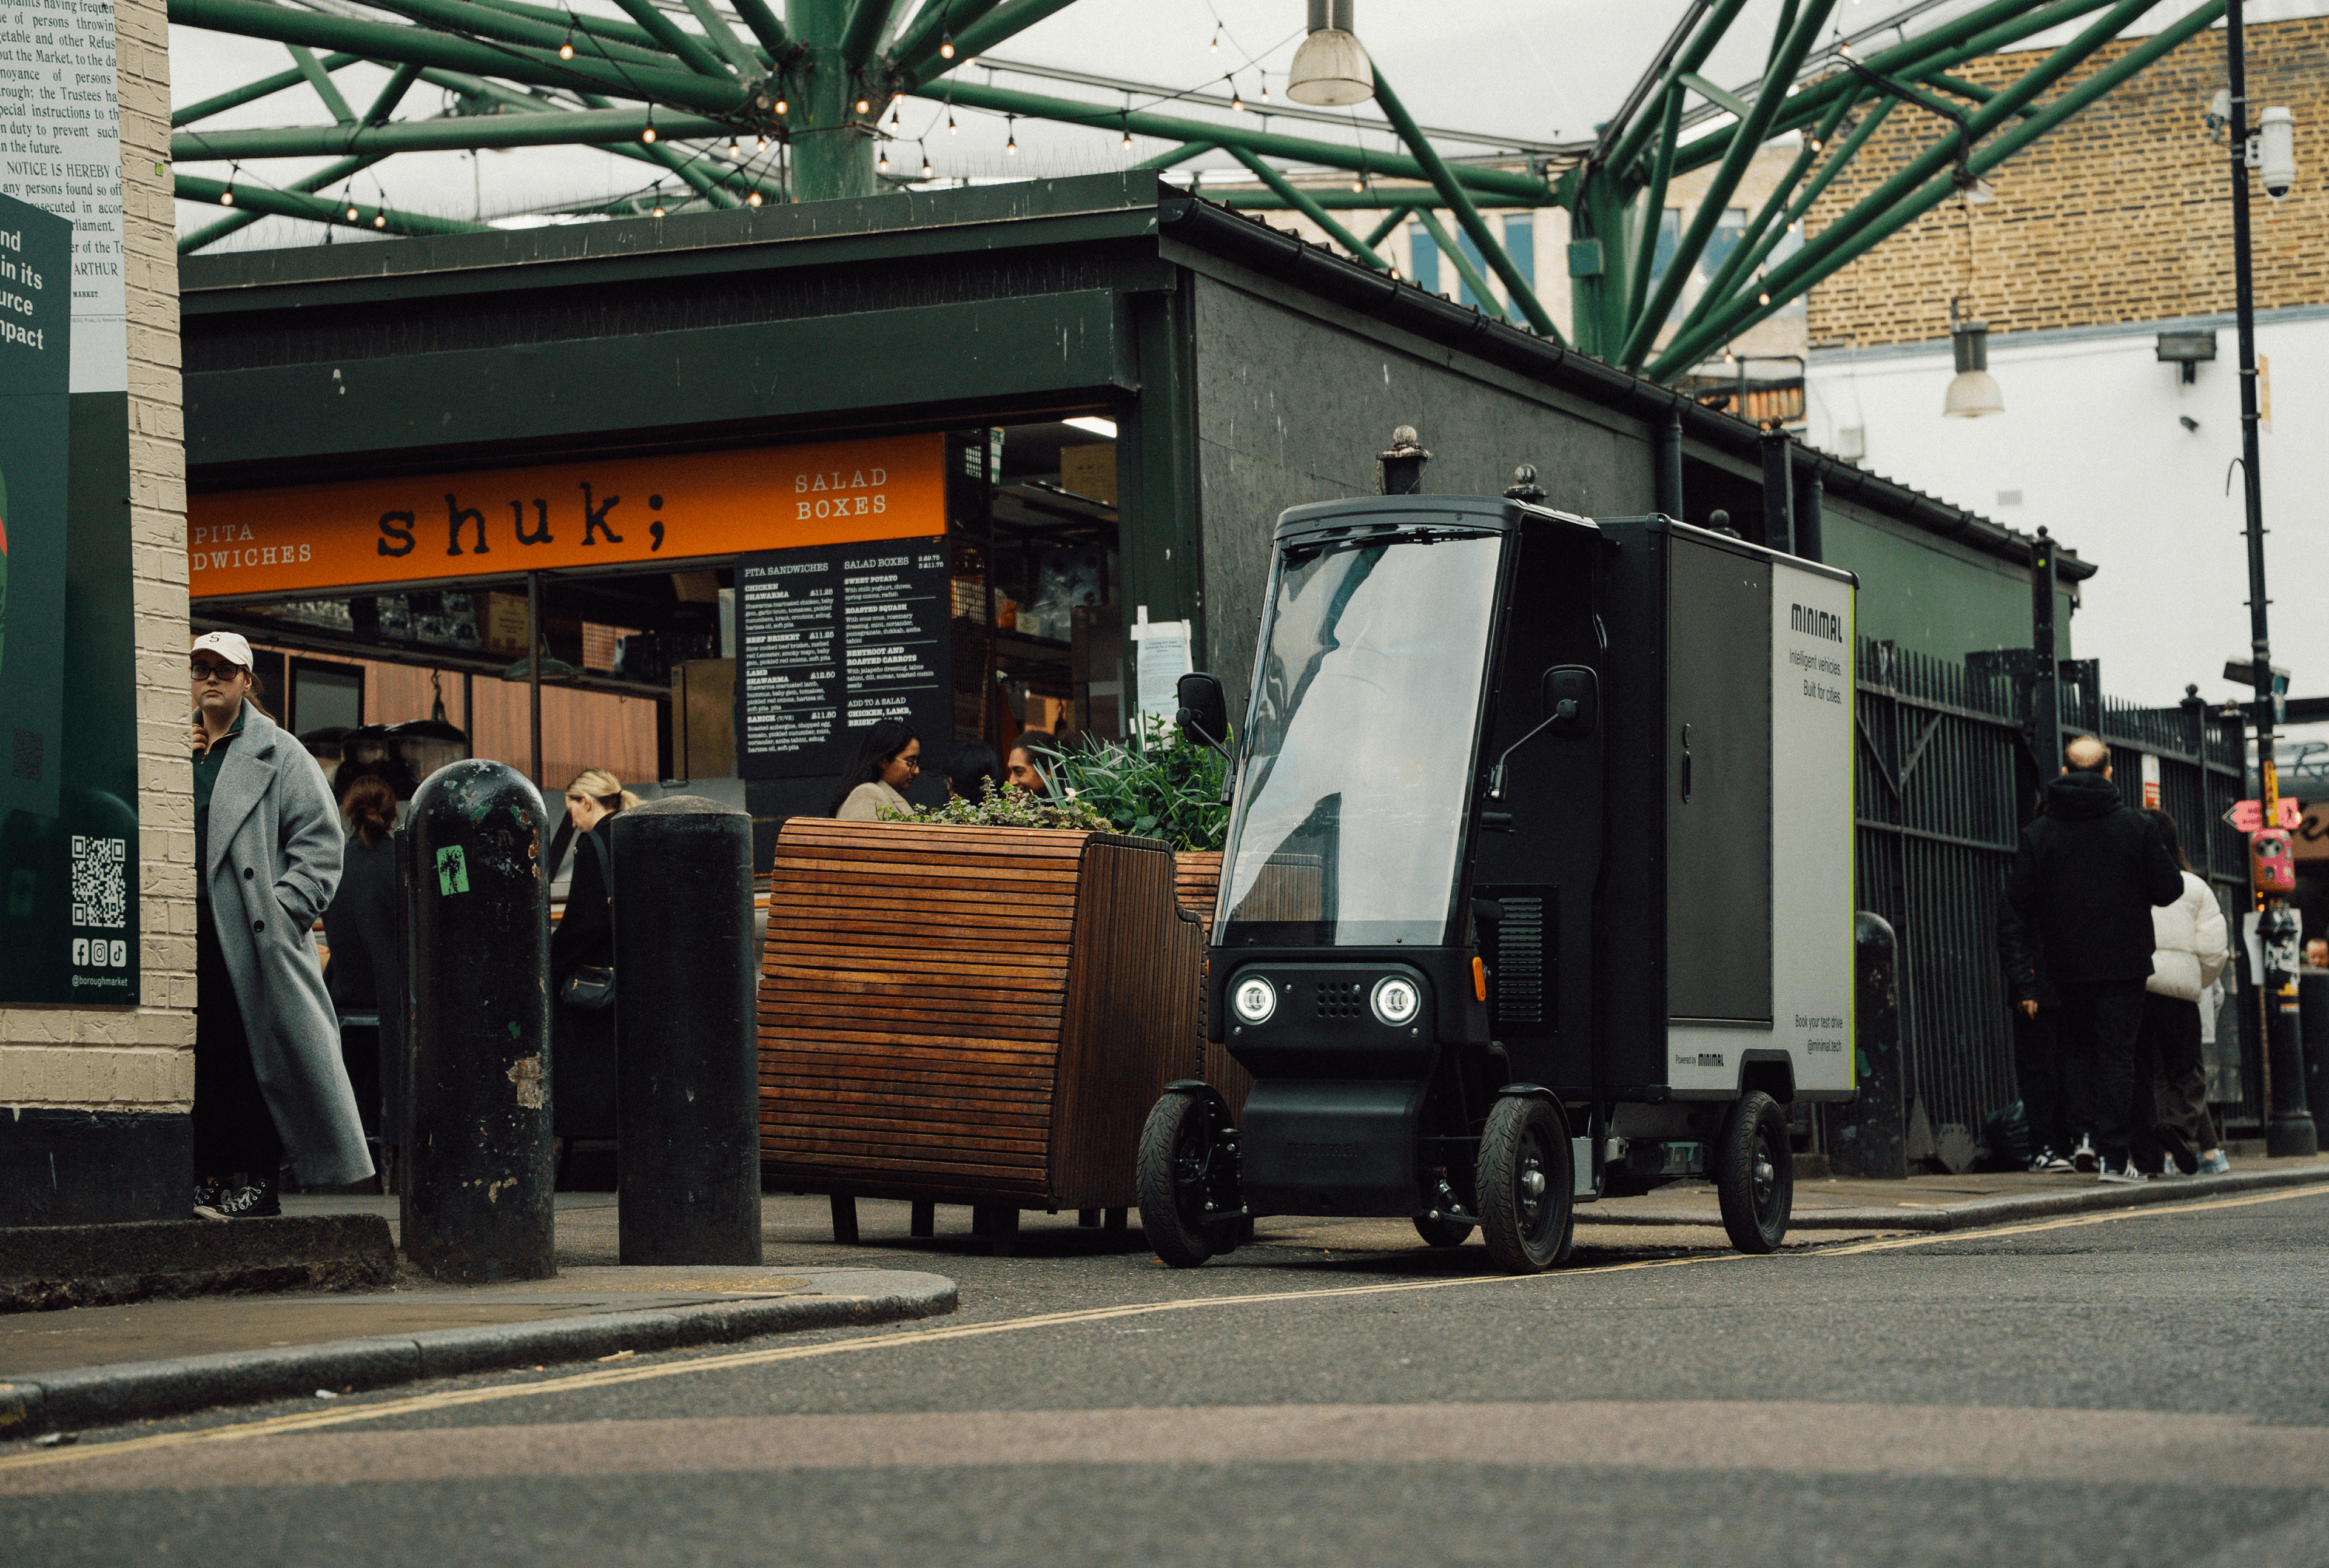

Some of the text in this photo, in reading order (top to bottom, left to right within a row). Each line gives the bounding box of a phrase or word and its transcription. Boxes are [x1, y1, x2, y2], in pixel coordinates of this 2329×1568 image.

[44, 0, 76, 14] having
[15, 12, 23, 24] of
[33, 16, 69, 29] persons
[0, 30, 30, 44] etable
[36, 33, 53, 45] and
[59, 34, 84, 47] other
[16, 49, 32, 61] the
[36, 50, 73, 66] Market,
[76, 54, 86, 65] to
[87, 54, 103, 66] the
[53, 69, 61, 82] of
[75, 73, 112, 86] persons
[39, 86, 55, 99] the
[60, 87, 101, 101] Trustees
[32, 104, 90, 119] instructions
[95, 108, 104, 119] to
[10, 122, 32, 137] duty
[37, 124, 46, 135] to
[53, 126, 89, 138] prevent
[97, 126, 118, 138] such
[10, 140, 26, 152] the
[30, 141, 62, 154] future.
[7, 161, 47, 176] NOTICE
[52, 164, 62, 176] IS
[67, 164, 110, 178] HEREBY
[3, 183, 20, 196] any
[25, 184, 62, 197] persons
[66, 183, 92, 195] found
[97, 186, 106, 196] so
[82, 201, 92, 213] in
[82, 240, 91, 254] of
[95, 241, 110, 253] the
[21, 262, 42, 290] its
[74, 262, 119, 277] ARTHUR
[795, 468, 887, 493] SALAD
[796, 494, 887, 520] BOXES
[377, 482, 665, 557] shuk;
[194, 523, 255, 545] PITA
[192, 543, 311, 571] DWICHES
[844, 557, 909, 570] SALAD BOXES
[745, 563, 828, 577] PITA SANDWICHES
[870, 574, 898, 583] POTATO
[745, 583, 779, 592] CHICKEN
[745, 591, 789, 601] SHAWARMA
[845, 604, 907, 614] ROASTED SQUASH
[210, 634, 220, 642] S
[767, 633, 800, 642] BRISKET
[847, 648, 886, 657] BEETROOT
[847, 654, 917, 666] ROASTED CARROTS
[1789, 647, 1842, 676] Intelligent vehicles.
[747, 676, 789, 685] SHAWARMA
[1804, 679, 1816, 698] Built
[1826, 686, 1842, 704] cities.
[747, 715, 776, 723] SABICH
[848, 708, 885, 717] CHICKEN,
[72, 975, 128, 988] @boroughmarket
[1795, 1014, 1843, 1031] Book your test drive
[1807, 1039, 1842, 1054] @minimal.tech
[1675, 1055, 1690, 1065] Powered
[1691, 1055, 1696, 1066] by
